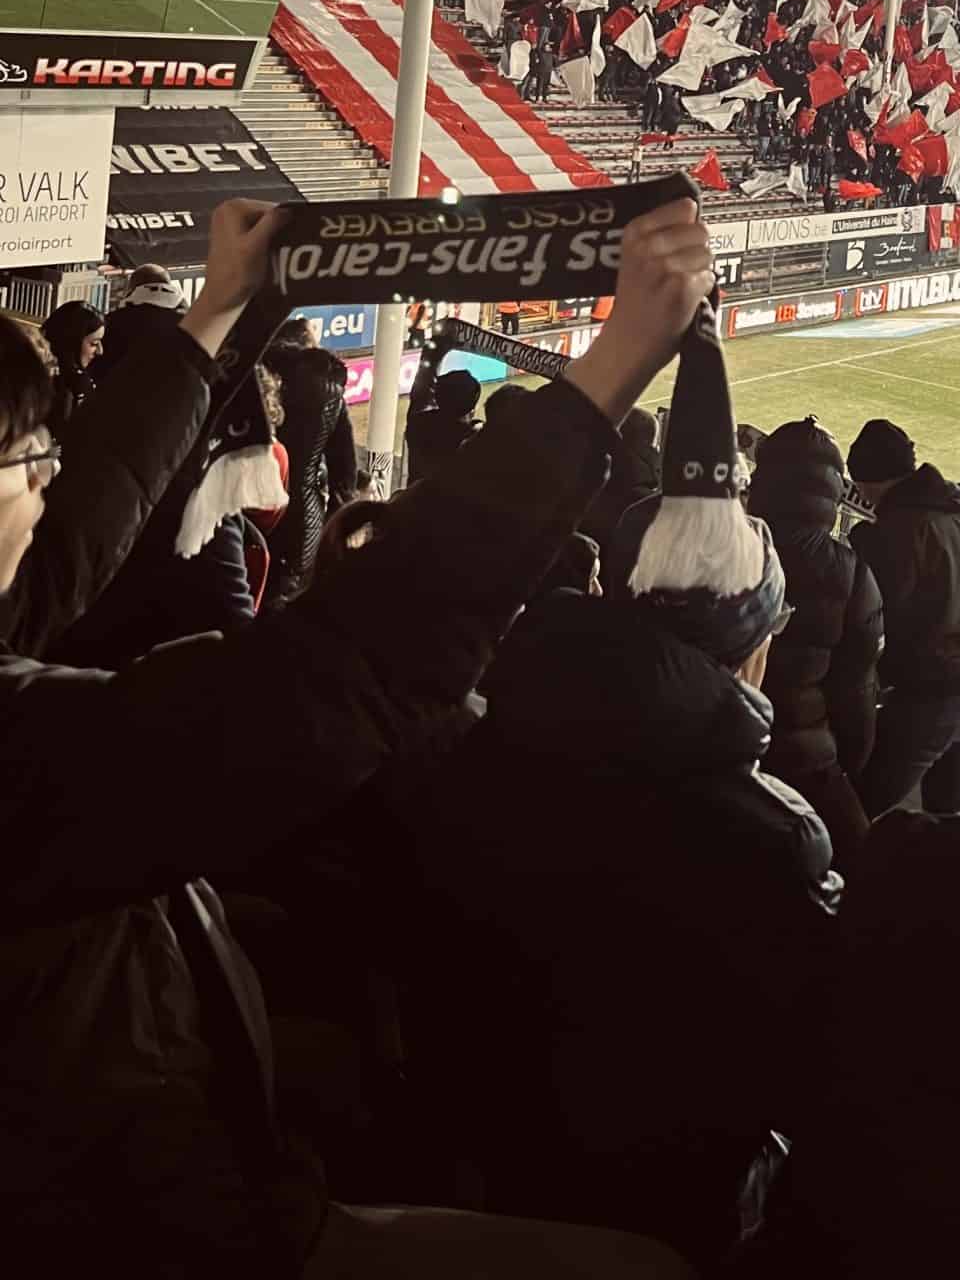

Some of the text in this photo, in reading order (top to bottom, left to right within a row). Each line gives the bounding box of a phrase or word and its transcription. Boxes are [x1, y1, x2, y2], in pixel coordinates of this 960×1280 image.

[110, 142, 268, 174] NIBET
[19, 170, 89, 202] VALK
[0, 204, 89, 224] OI AIRPORT
[0, 234, 73, 253] roiairport
[751, 217, 811, 244] UMONS
[273, 226, 624, 296] es fans-carol
